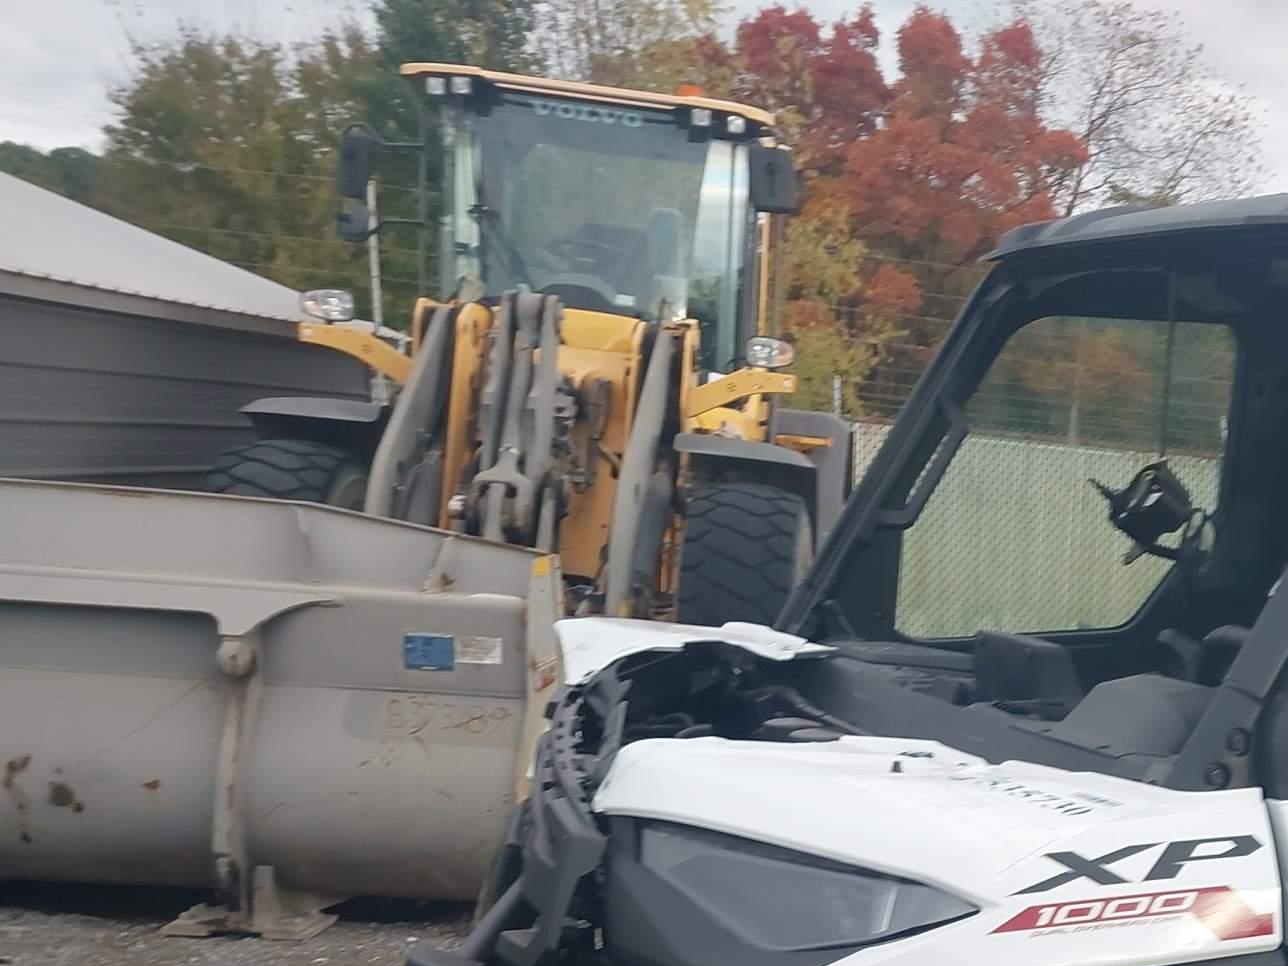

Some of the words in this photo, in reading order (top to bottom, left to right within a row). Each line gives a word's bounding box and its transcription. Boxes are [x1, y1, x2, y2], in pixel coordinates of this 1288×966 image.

[527, 99, 643, 128] VOLVO
[1009, 834, 1264, 897] XP
[1034, 890, 1200, 928] 1000
